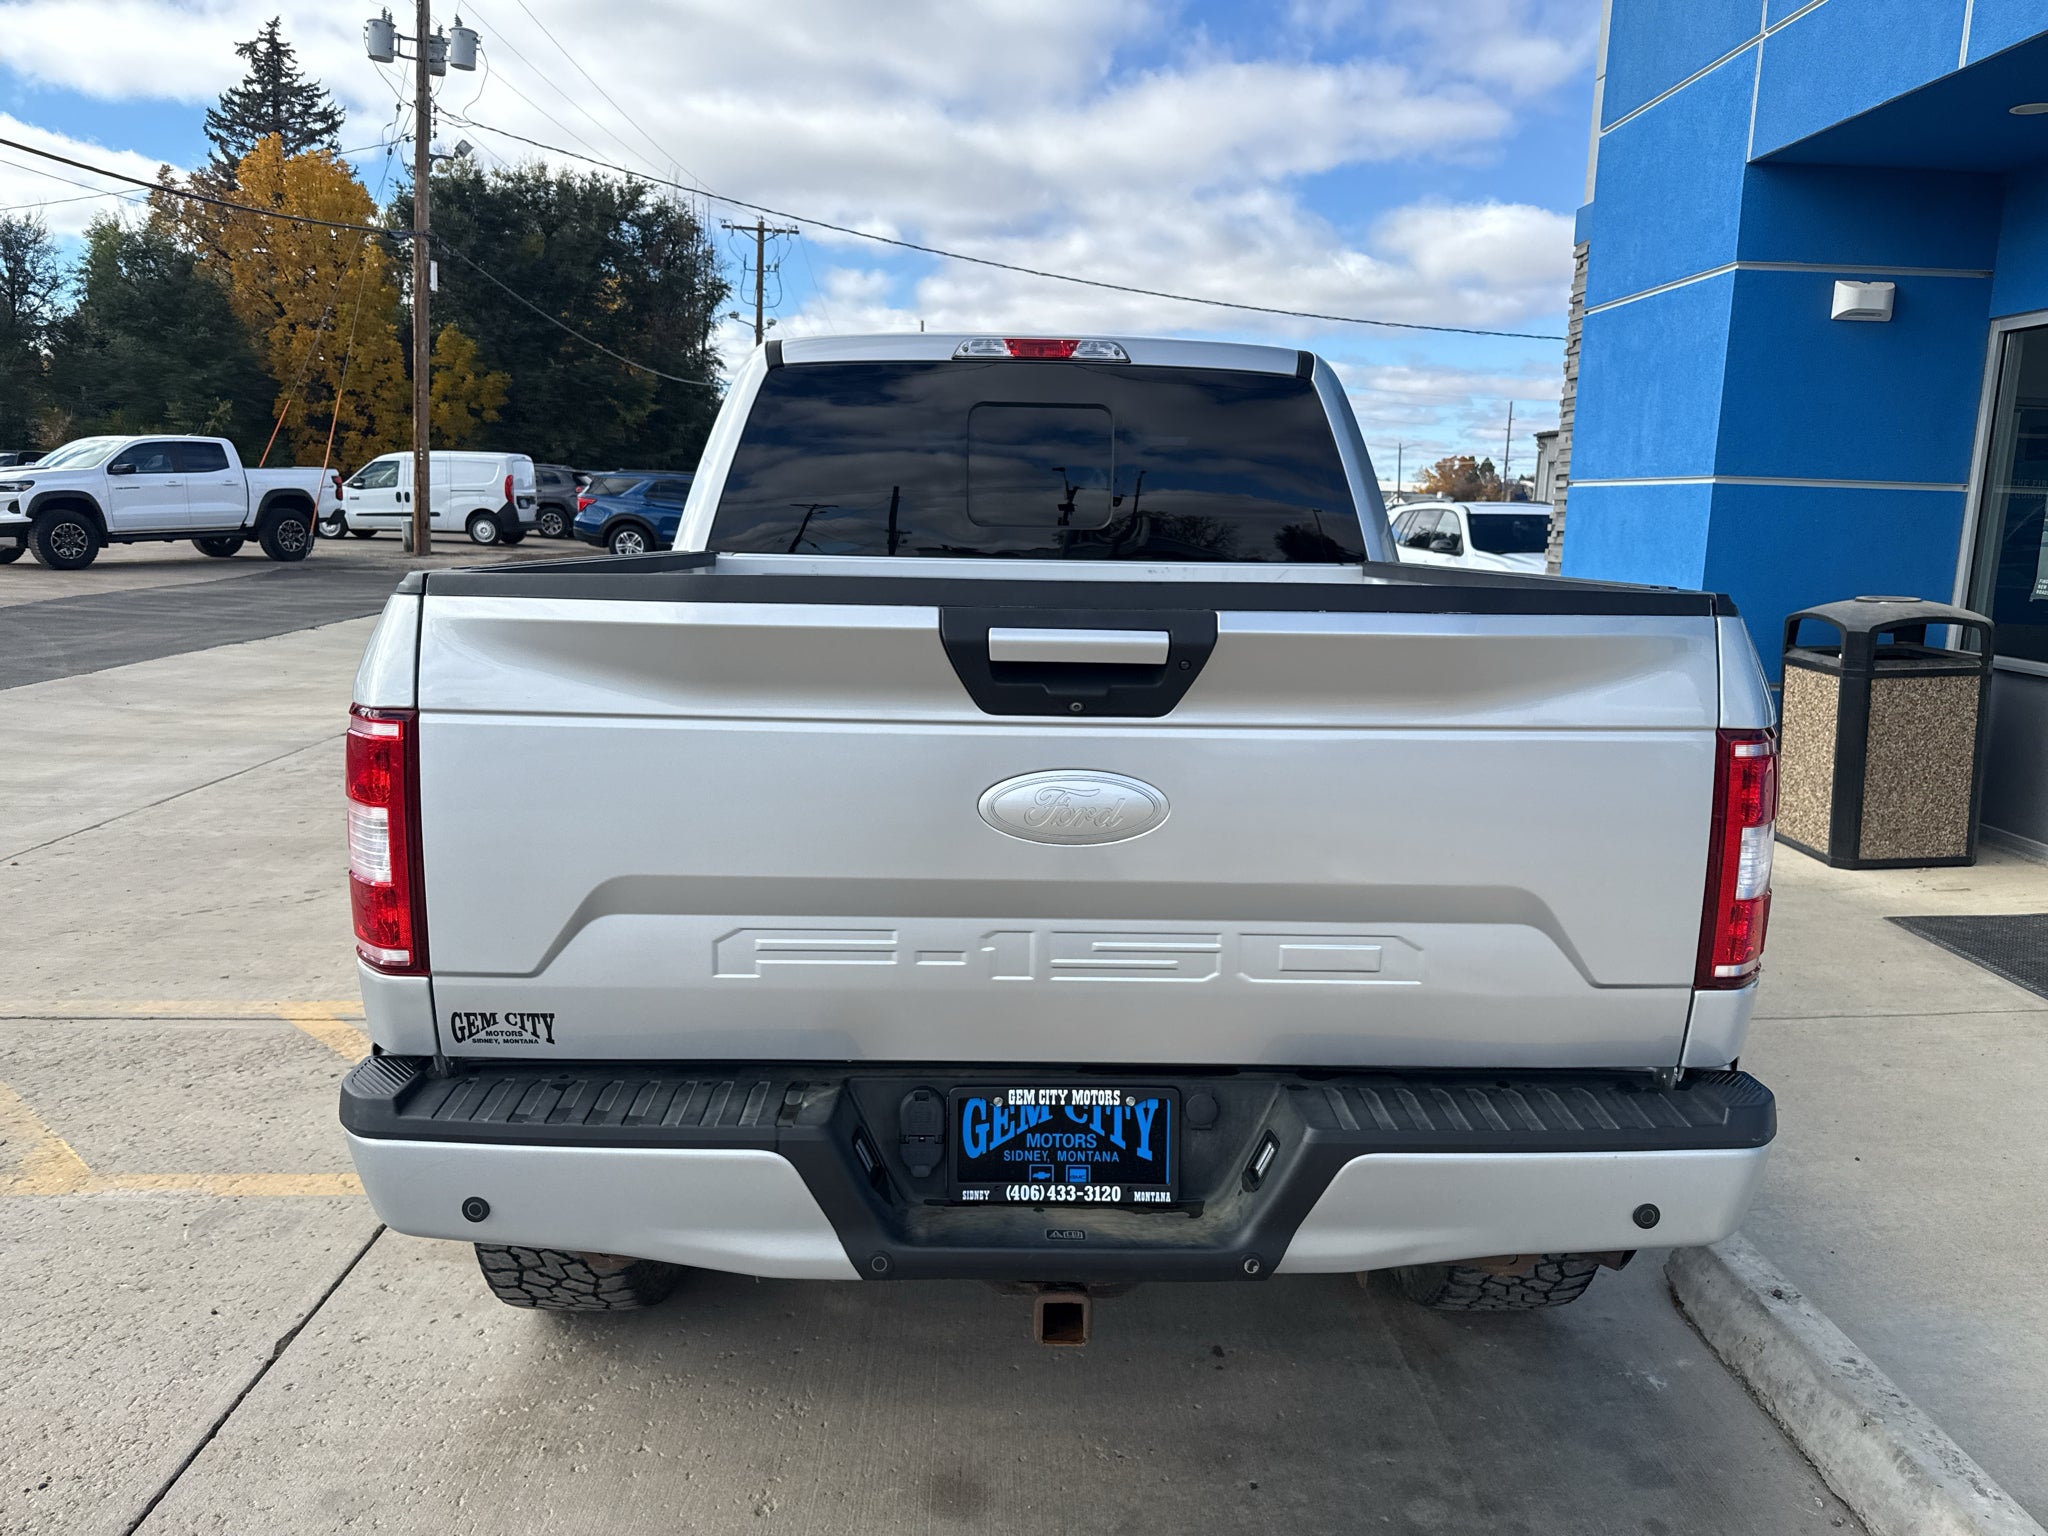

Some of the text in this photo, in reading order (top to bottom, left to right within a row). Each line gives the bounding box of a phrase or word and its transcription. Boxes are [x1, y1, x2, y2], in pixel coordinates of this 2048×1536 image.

[1024, 786, 1126, 828] Ford
[712, 927, 1424, 985] F-150
[450, 1011, 556, 1045] GEM CITY
[1008, 1089, 1121, 1106] GEM CITY MOTORS
[1026, 1133, 1098, 1149] MOTORS
[1003, 1149, 1120, 1164] SIDNEY, MONTANA
[962, 1190, 990, 1201] SIDNEY
[1133, 1191, 1171, 1203] MONTANA
